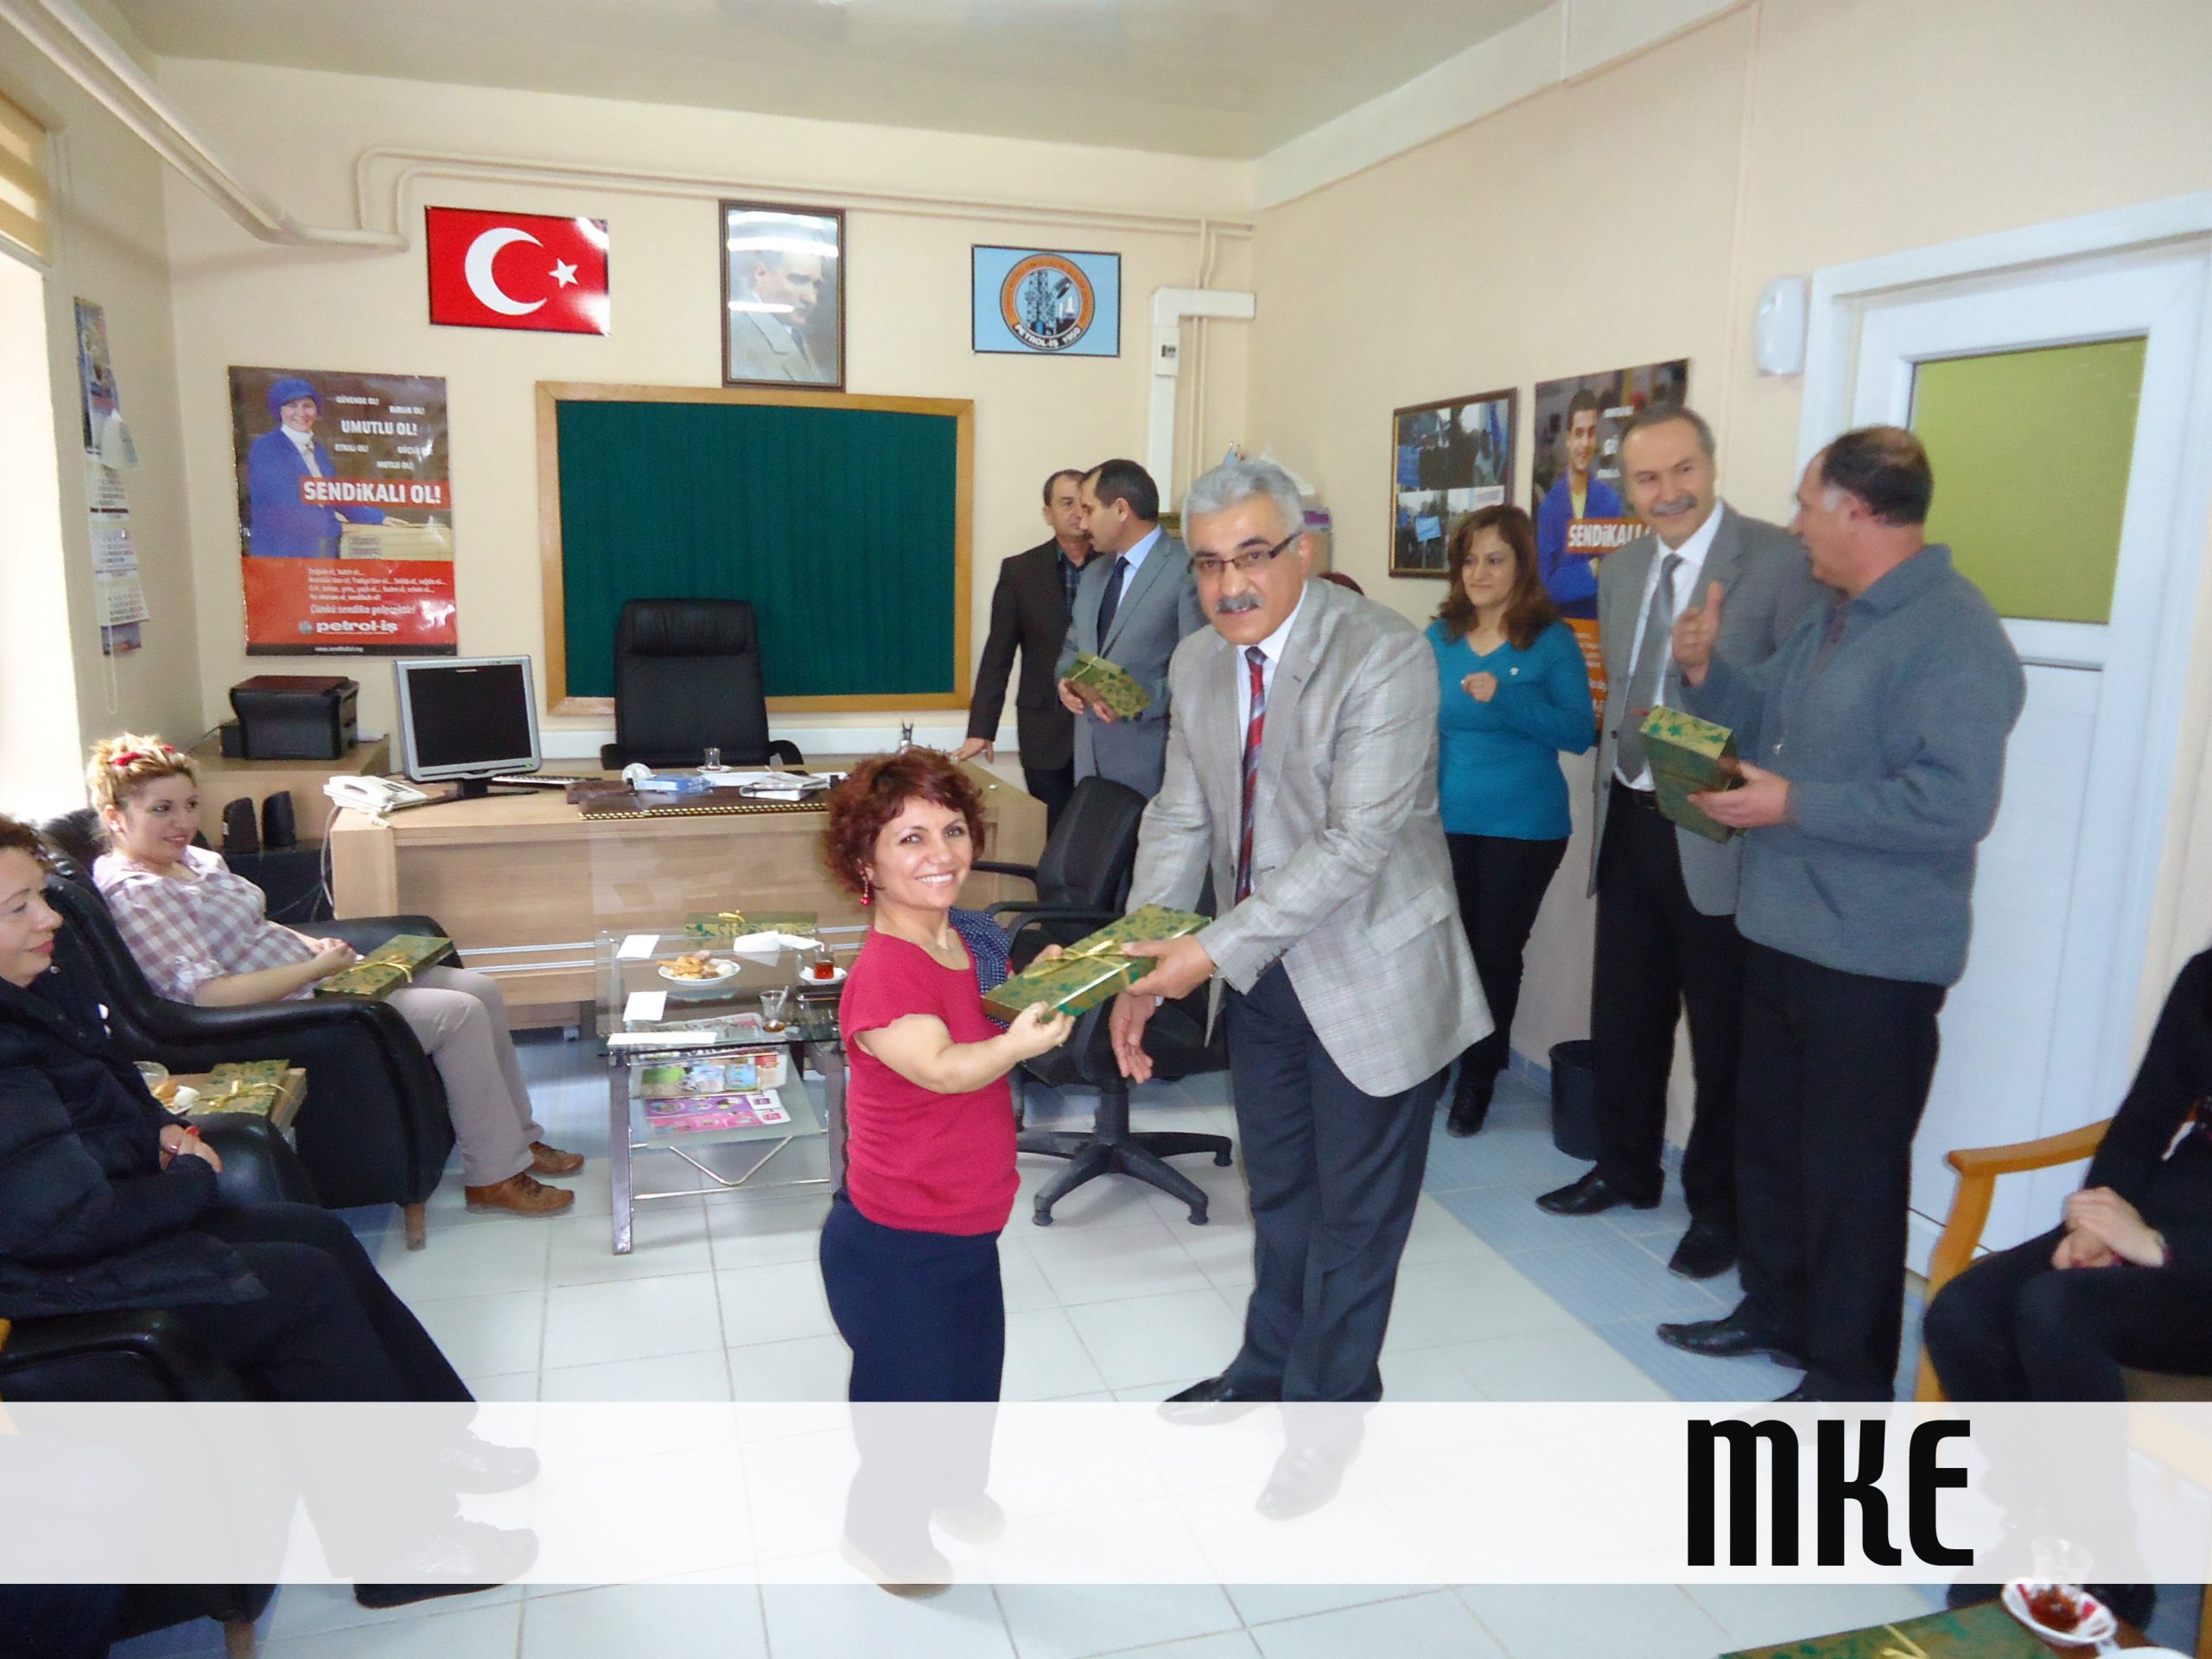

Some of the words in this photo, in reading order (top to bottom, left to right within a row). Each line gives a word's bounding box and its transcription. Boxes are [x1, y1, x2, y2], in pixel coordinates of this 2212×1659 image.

[340, 420, 394, 435] UMUTLU
[396, 423, 418, 436] OL!
[410, 484, 442, 504] OL!
[316, 620, 399, 634] petrol-iş
